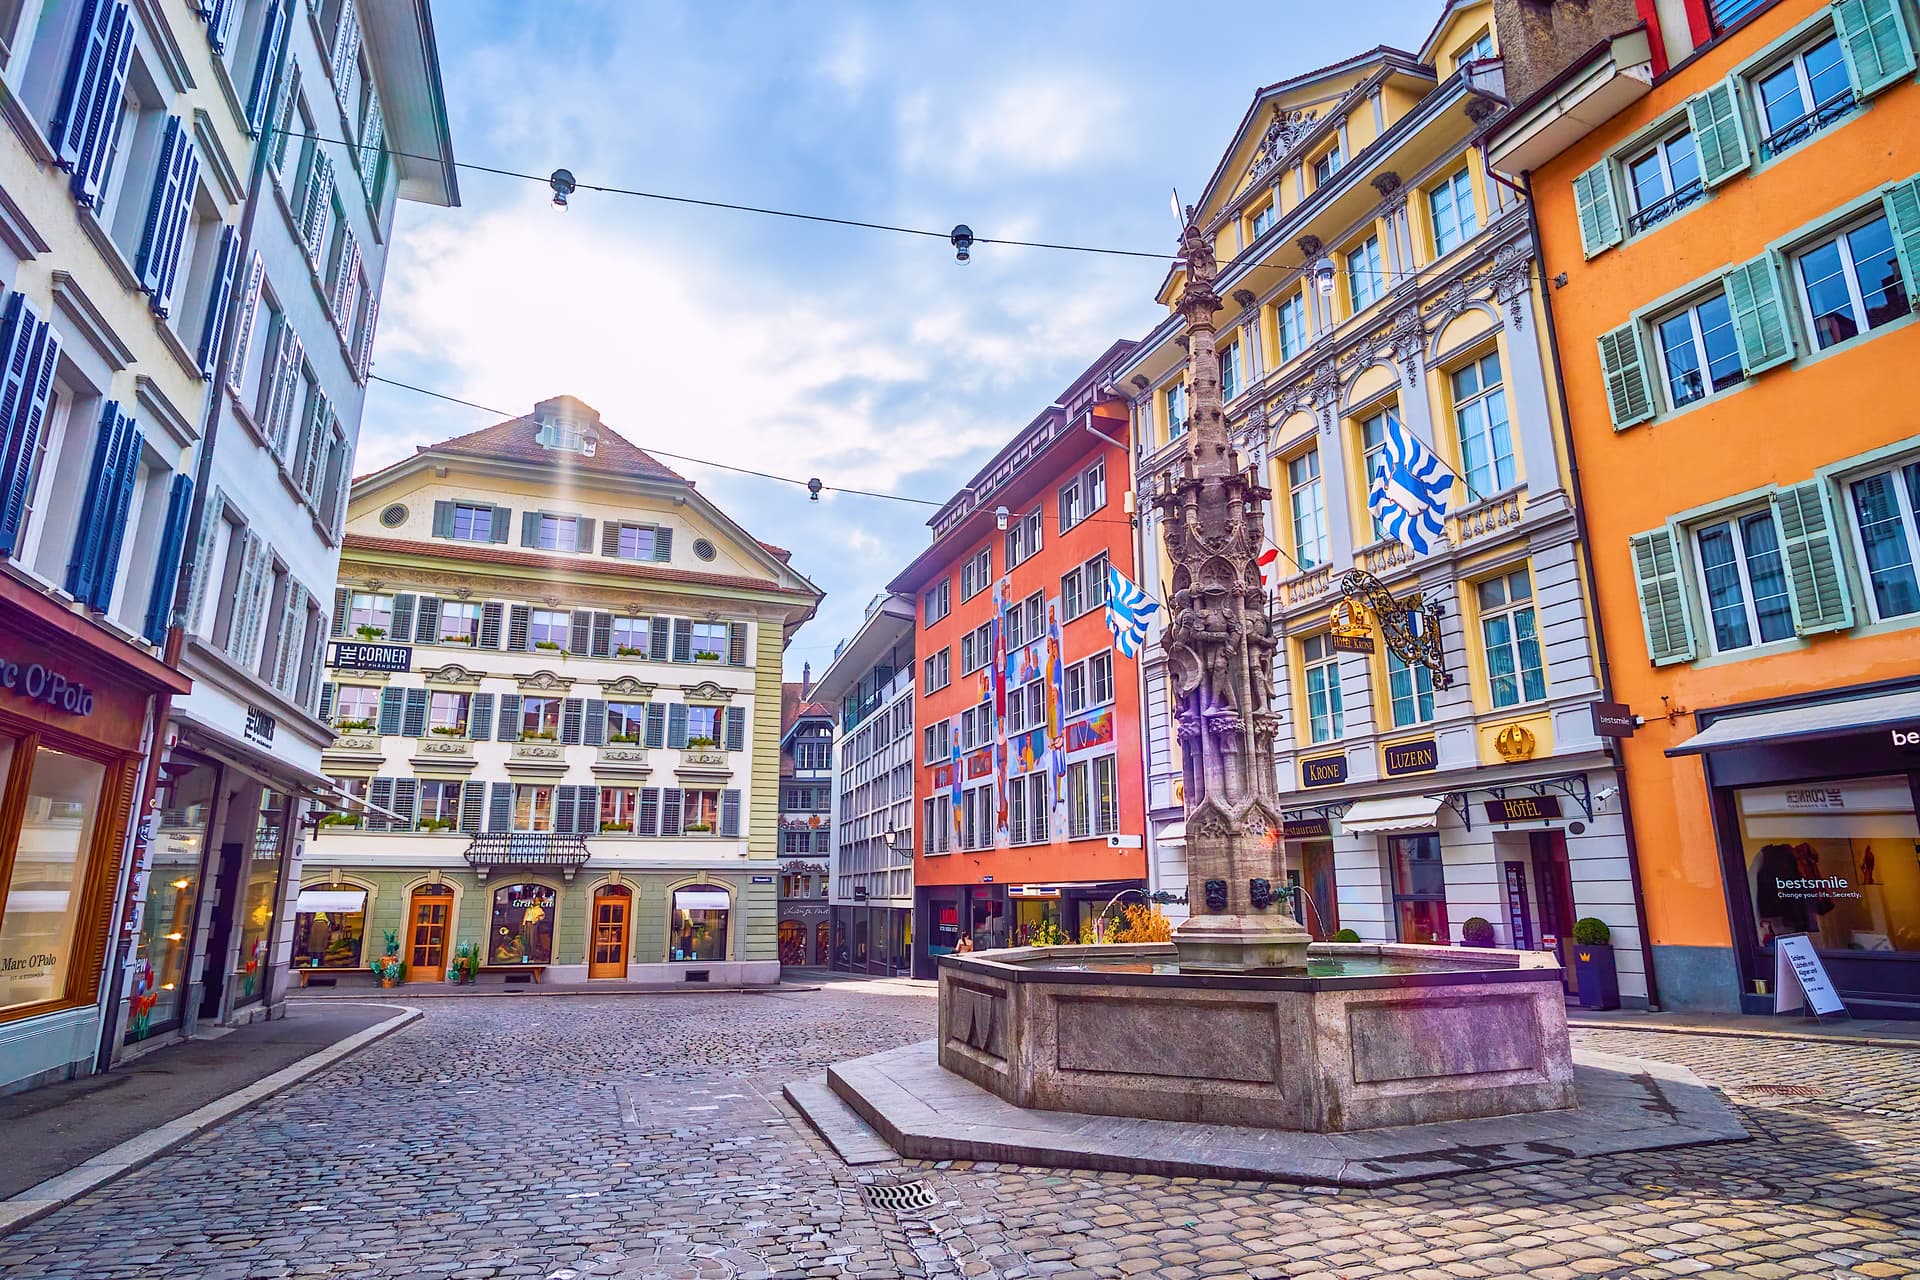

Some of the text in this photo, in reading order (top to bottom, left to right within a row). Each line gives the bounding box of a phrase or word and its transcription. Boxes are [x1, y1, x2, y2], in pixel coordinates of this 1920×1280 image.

[339, 645, 357, 666] THE
[358, 646, 407, 664] CORNER
[1599, 714, 1630, 725] bestsmile
[1390, 748, 1433, 770] LUZERN
[1309, 763, 1340, 781] KRONE
[1775, 876, 1848, 889] bestsmile
[1777, 891, 1802, 899] Change
[1, 953, 57, 972] Marc O'Polo
